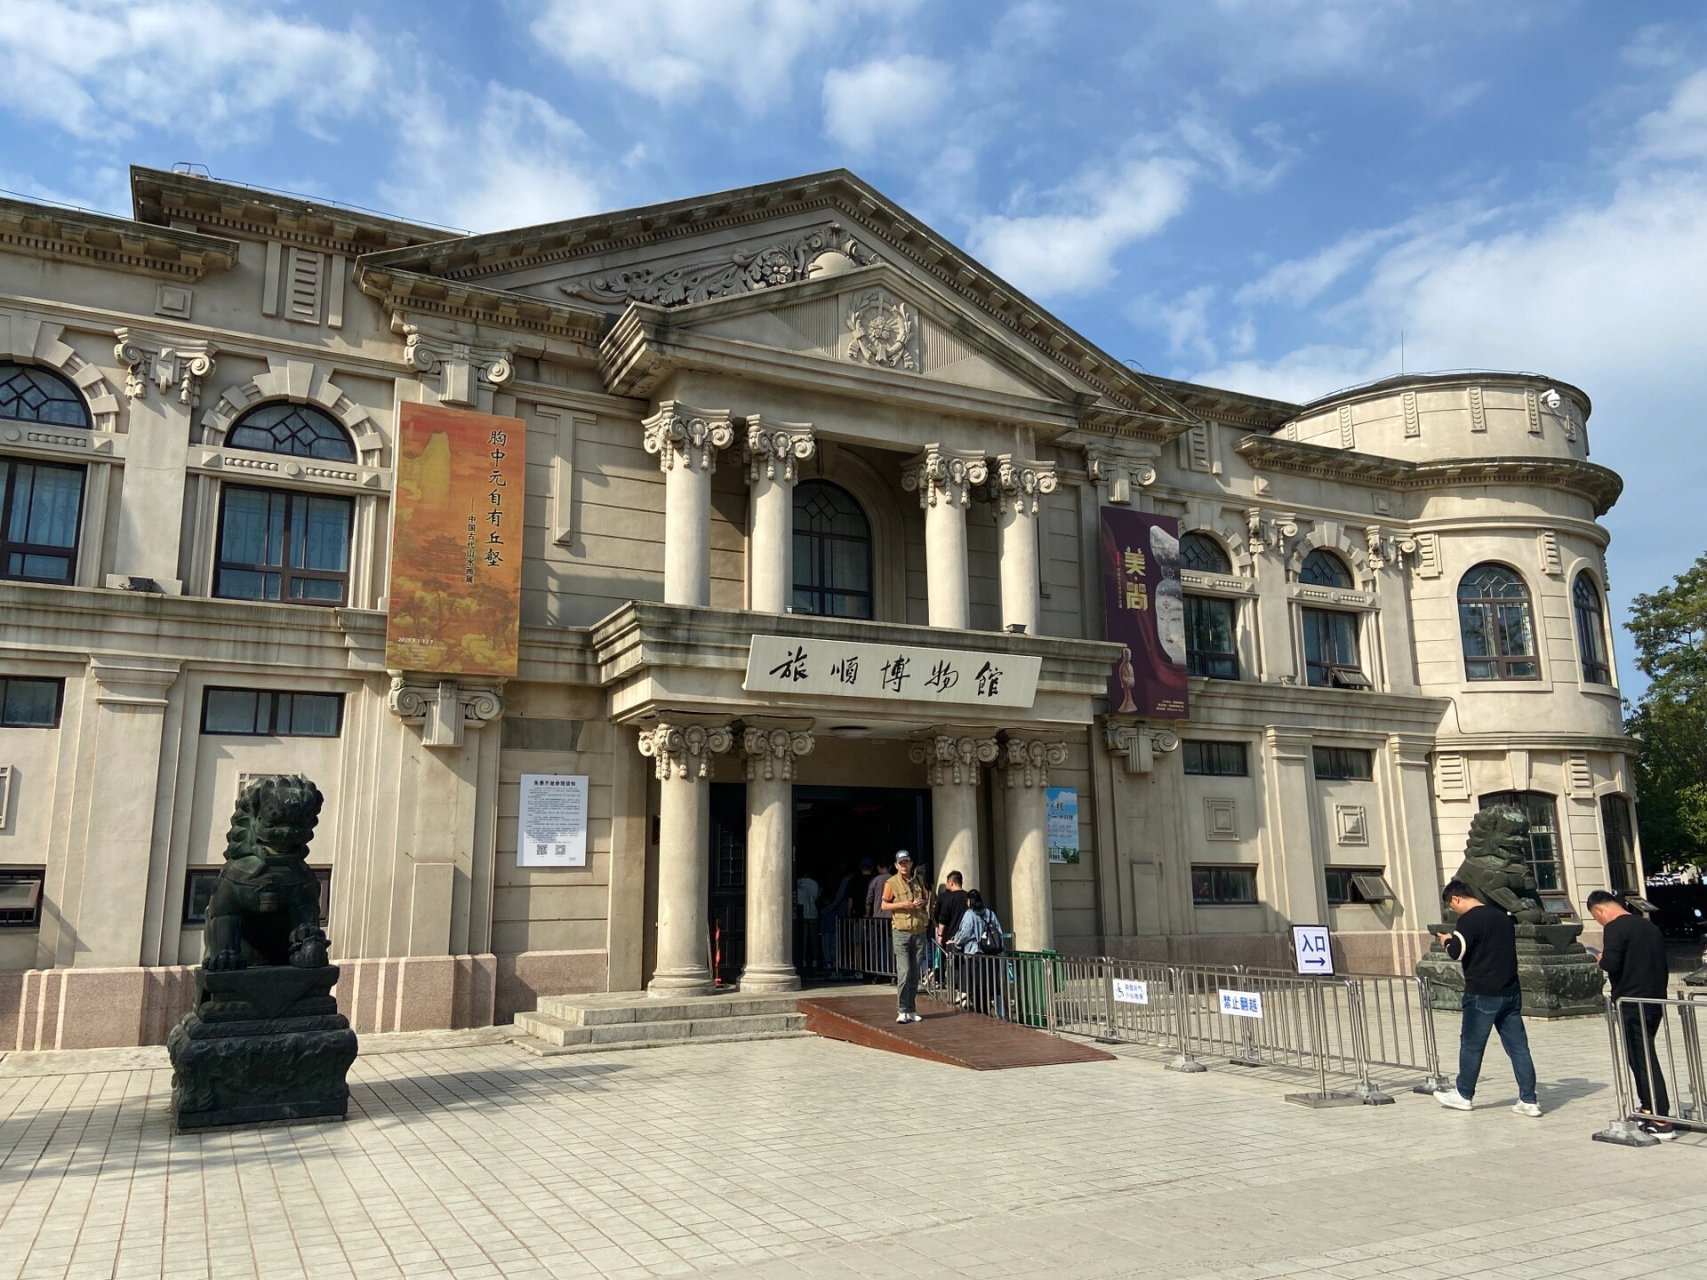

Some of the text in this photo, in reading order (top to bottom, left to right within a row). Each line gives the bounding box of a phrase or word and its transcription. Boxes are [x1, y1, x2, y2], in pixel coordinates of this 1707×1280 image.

[484, 430, 507, 567] 胸中元自有丘壑
[769, 645, 1003, 697] 旅順博物館
[1302, 934, 1326, 953] 入口
[1223, 994, 1258, 1013] 禁止翻越
